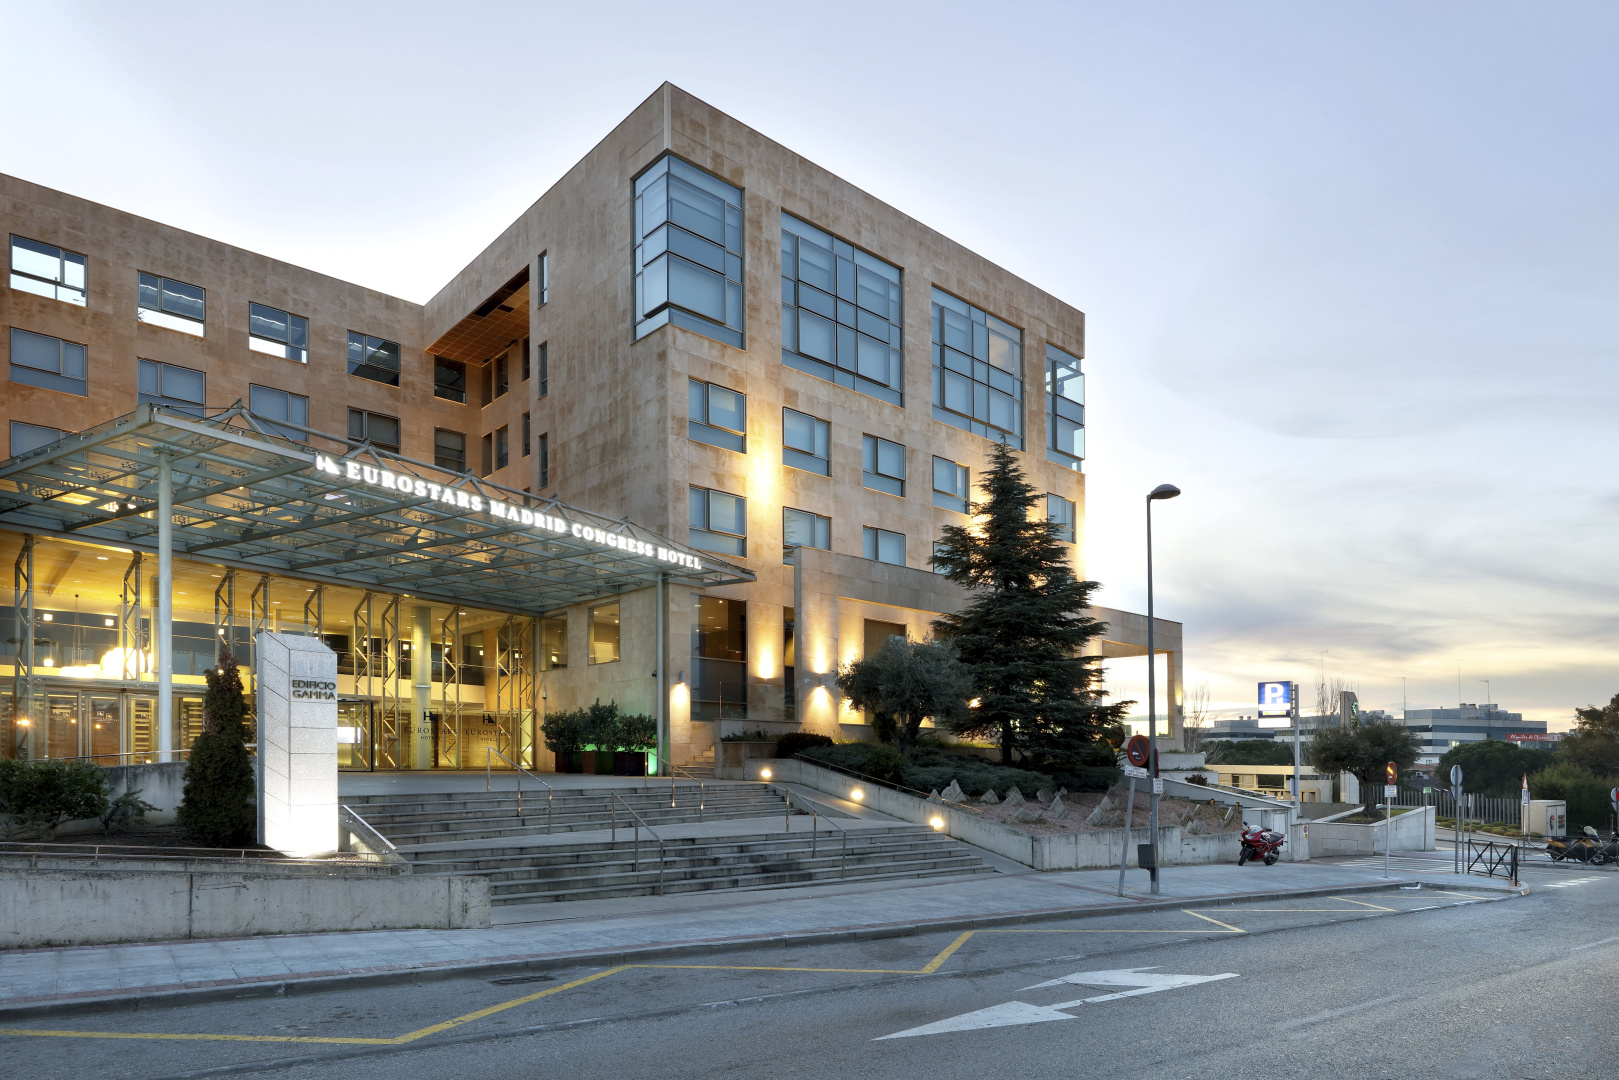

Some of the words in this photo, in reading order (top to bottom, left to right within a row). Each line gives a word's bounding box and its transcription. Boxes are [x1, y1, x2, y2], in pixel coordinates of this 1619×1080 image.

[345, 461, 482, 511] EUROSTARS
[489, 500, 566, 532] MADRID
[572, 523, 654, 556] CONGRESS
[657, 547, 702, 569] HOTEL
[292, 679, 336, 690] EDIFICIO
[292, 689, 336, 700] GAMMA
